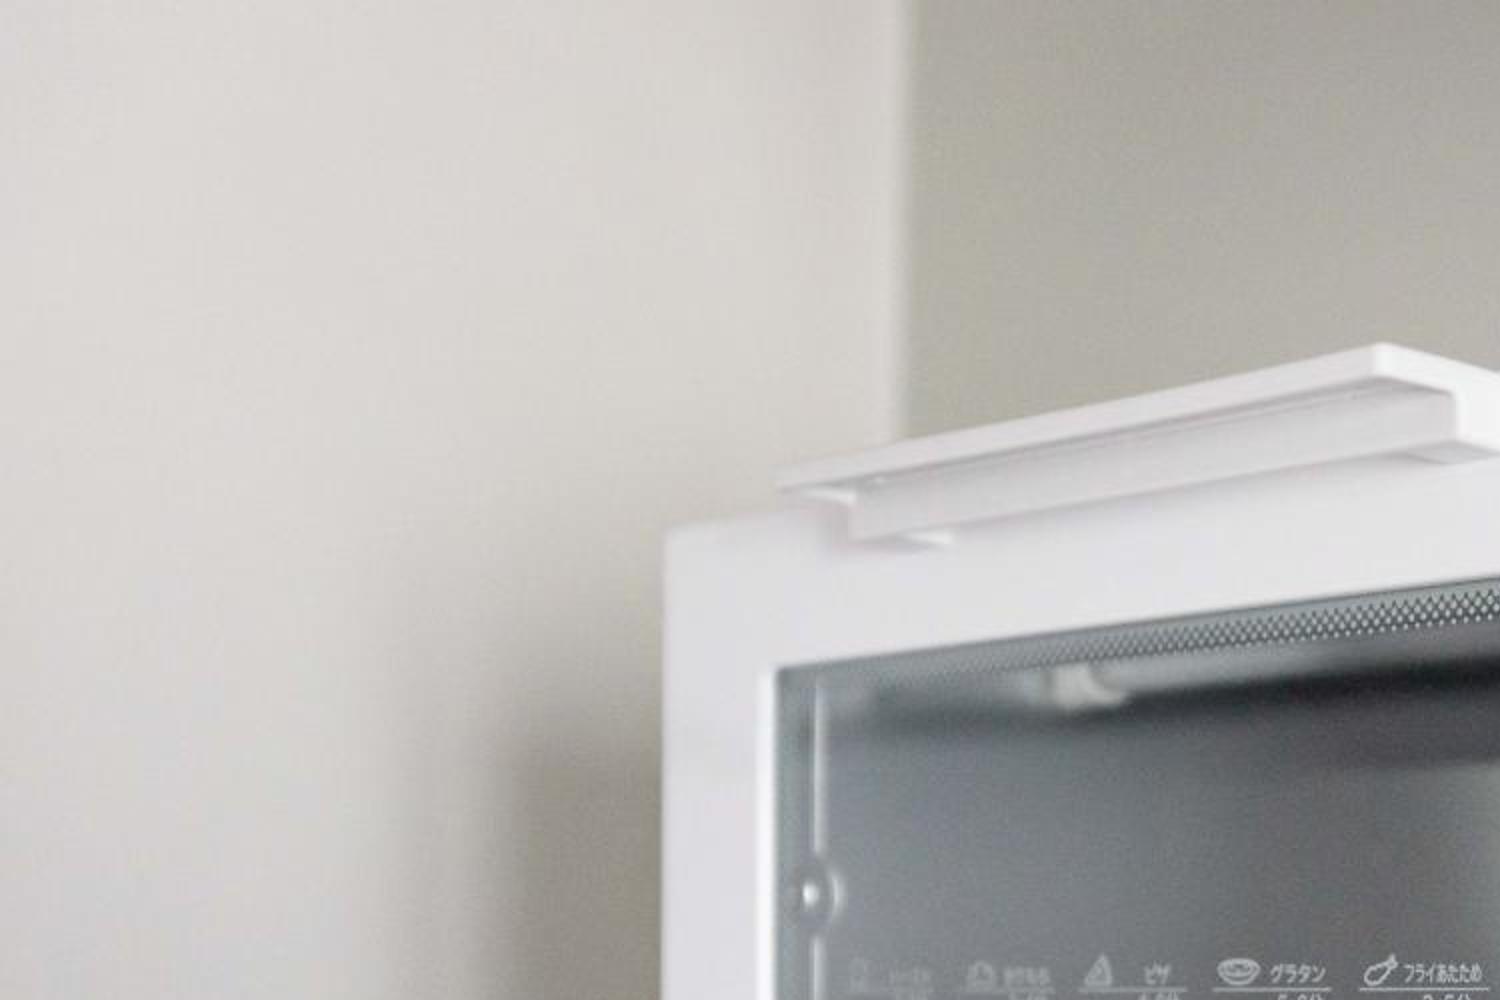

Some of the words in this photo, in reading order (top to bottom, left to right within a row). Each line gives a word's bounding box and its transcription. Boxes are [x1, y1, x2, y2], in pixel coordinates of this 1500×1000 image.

[1270, 963, 1326, 983] グラタン
[1404, 963, 1483, 984] フライあたため
